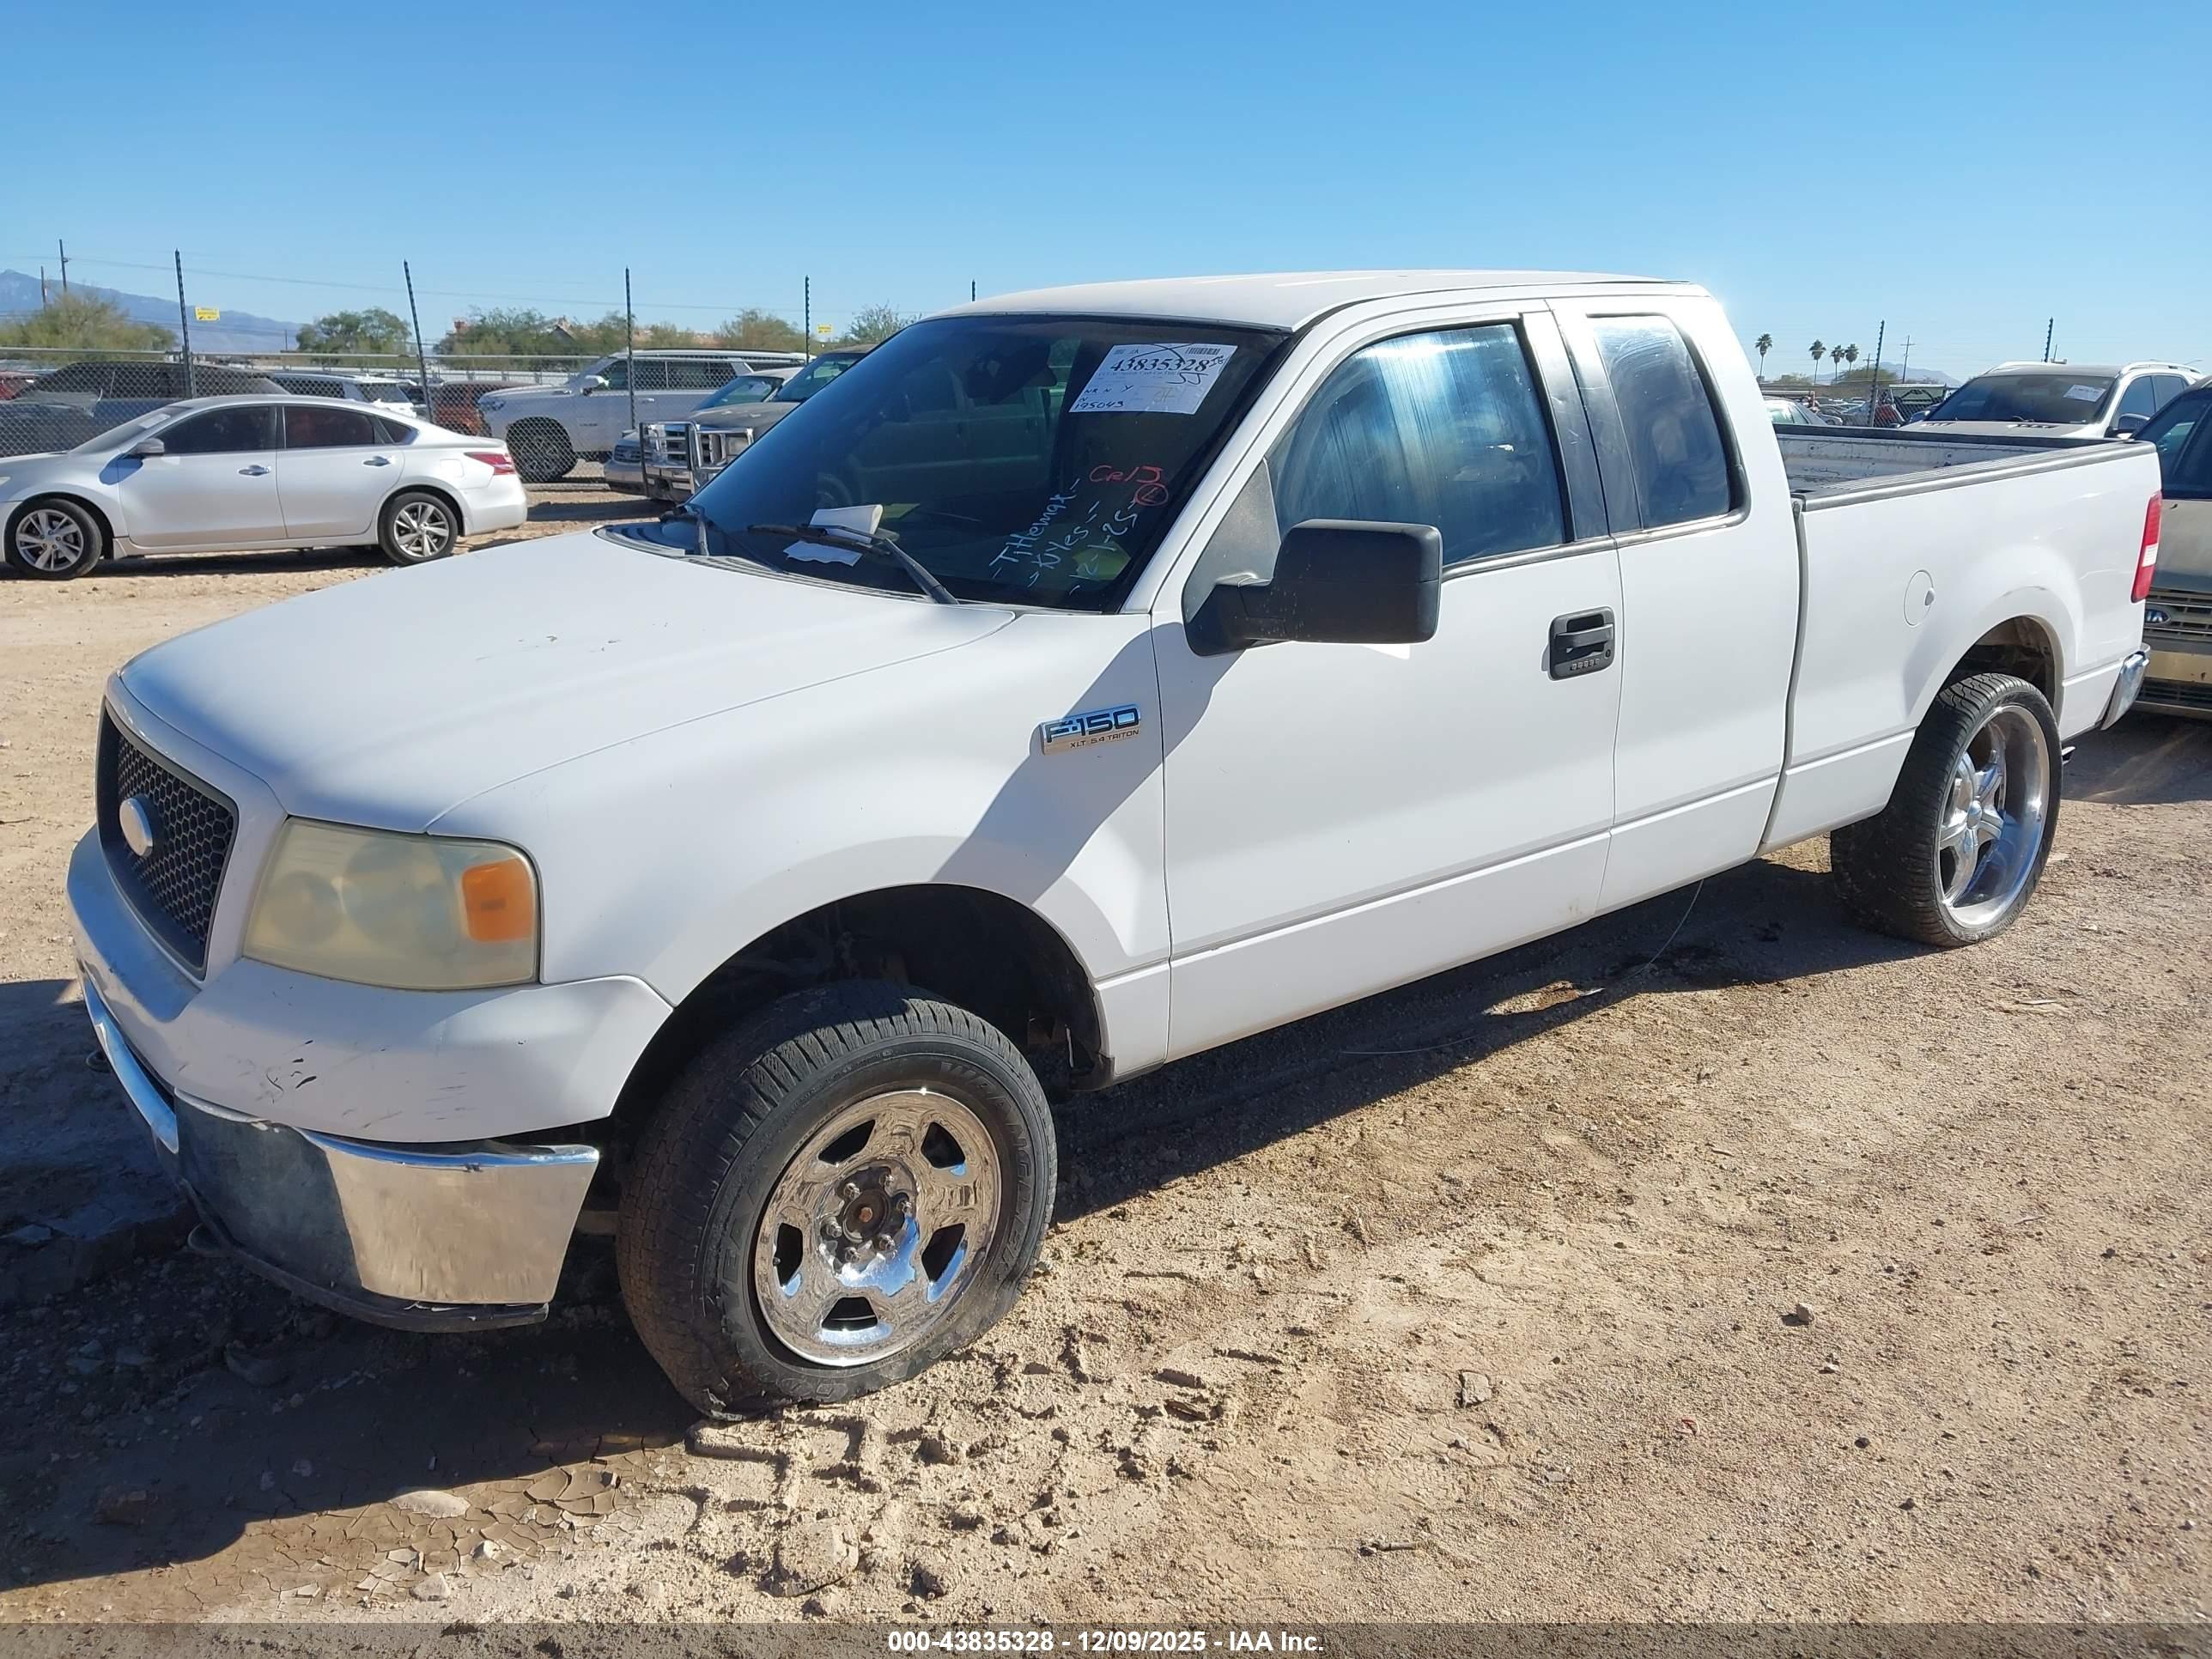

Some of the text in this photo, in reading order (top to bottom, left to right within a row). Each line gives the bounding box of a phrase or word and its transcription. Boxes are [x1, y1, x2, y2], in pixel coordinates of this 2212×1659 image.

[1110, 358, 1210, 372] 43835328
[1044, 708, 1140, 744] F-150
[1070, 739, 1087, 749] XLT
[1107, 729, 1140, 741] TRITON
